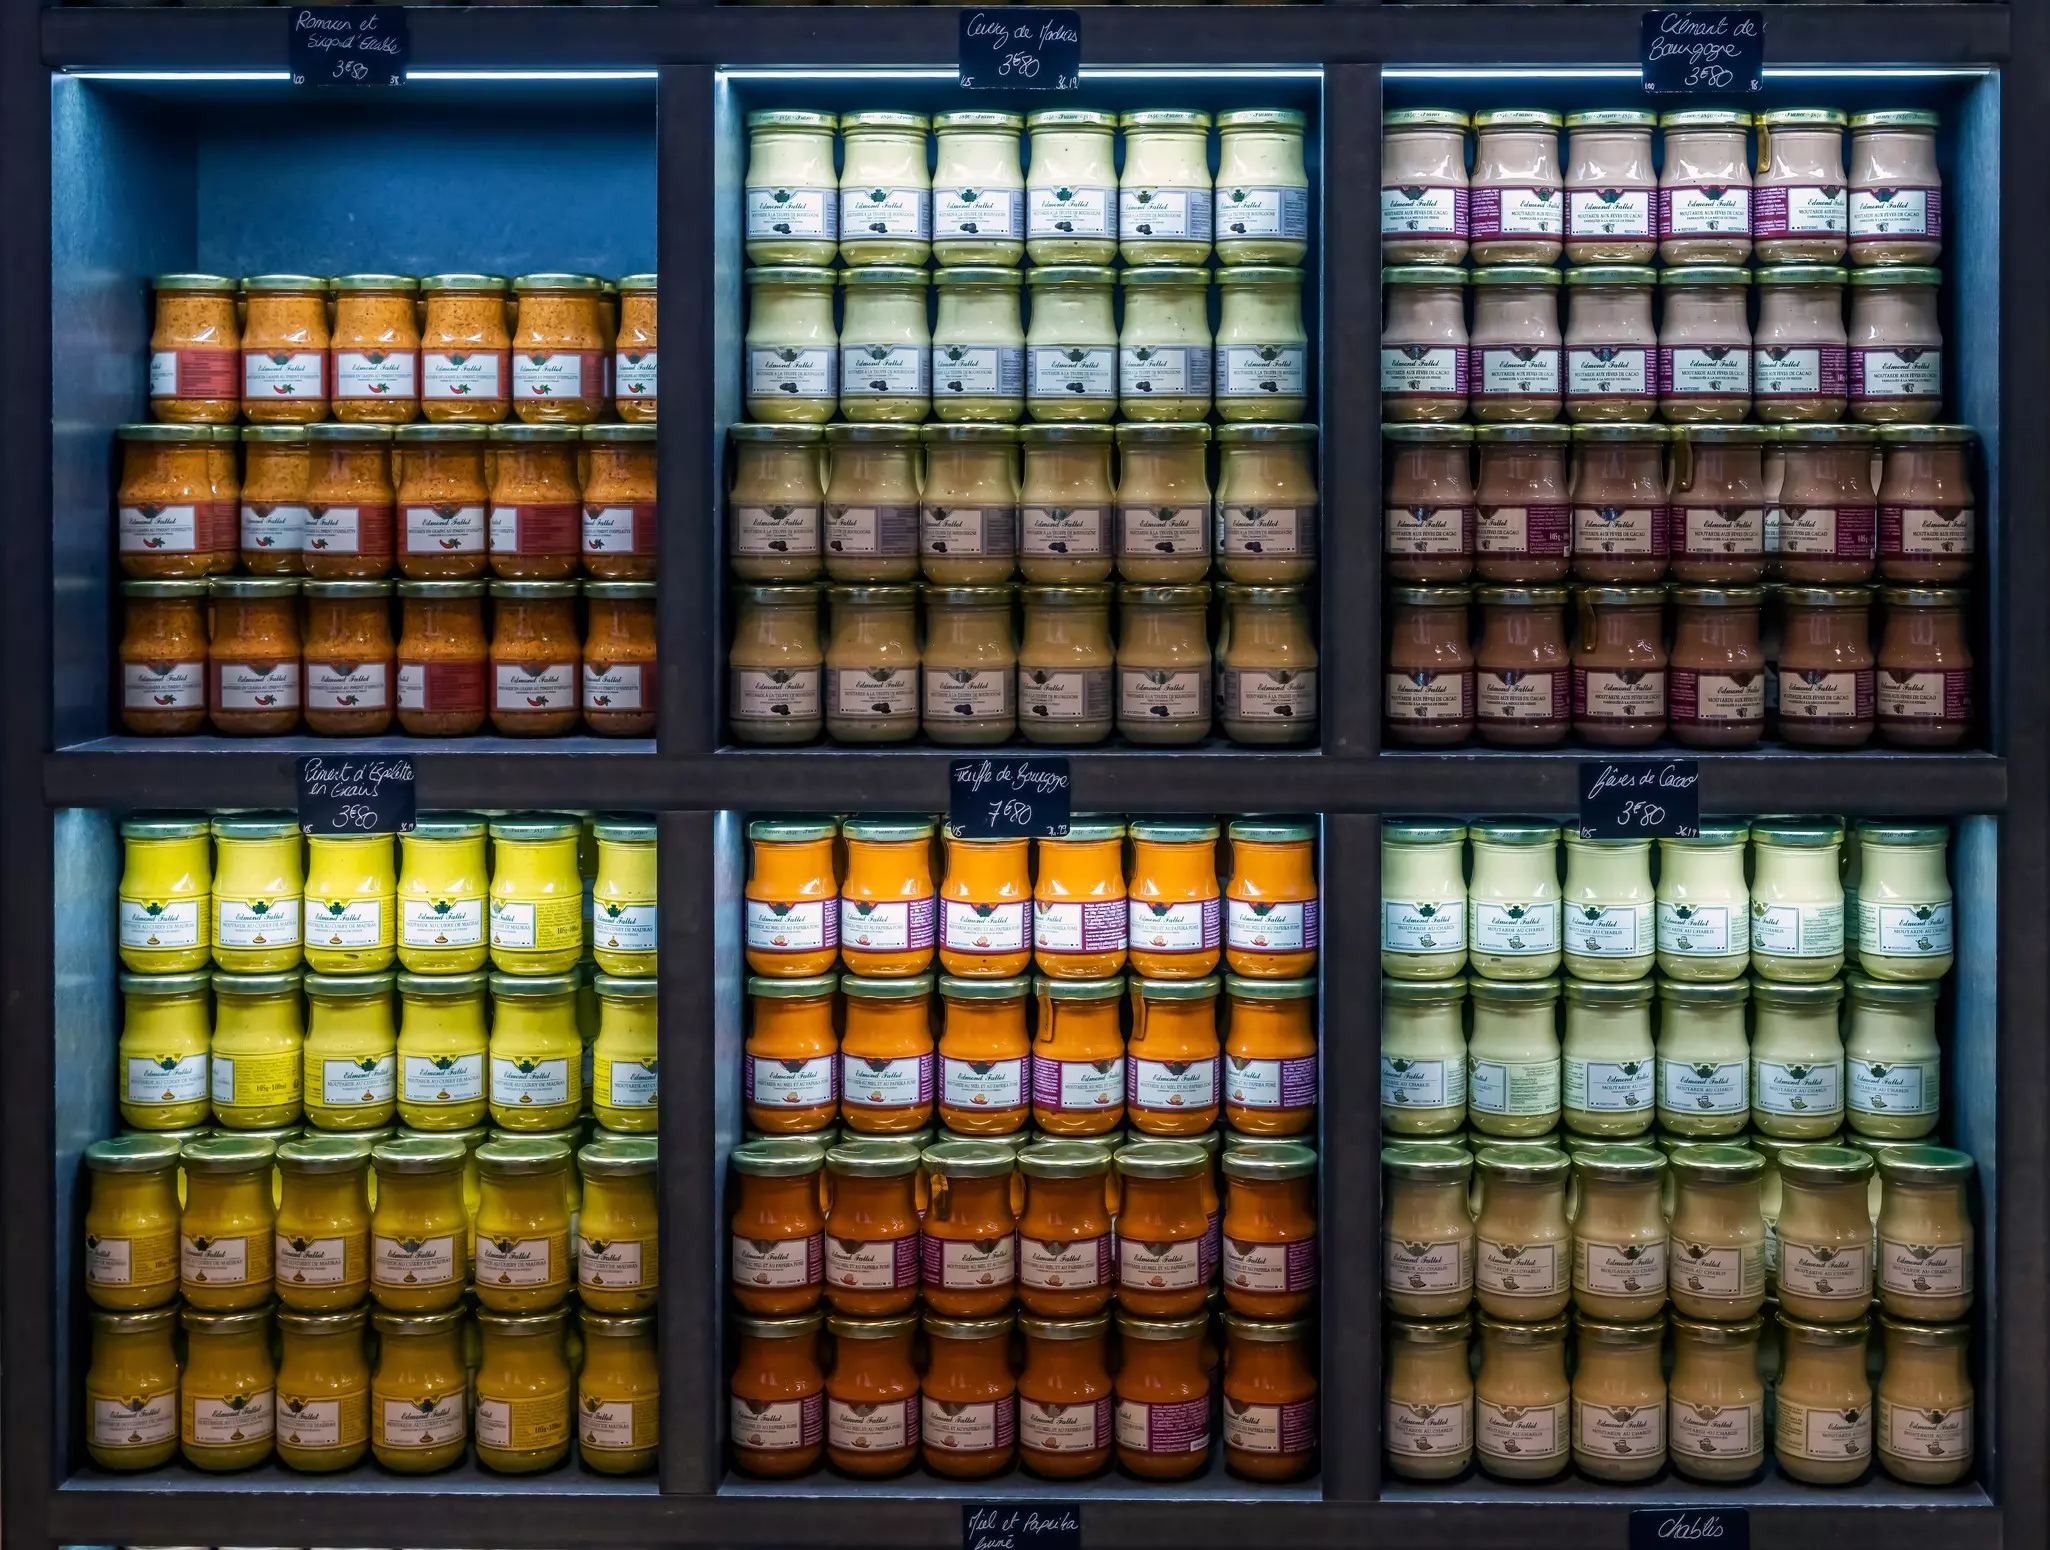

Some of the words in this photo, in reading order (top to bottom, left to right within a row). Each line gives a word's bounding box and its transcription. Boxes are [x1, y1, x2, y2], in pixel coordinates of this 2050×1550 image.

[360, 14, 379, 31] et
[967, 13, 1009, 50] Curry
[1013, 25, 1033, 39] de
[1733, 19, 1758, 37] de
[998, 51, 1040, 78] 3€80
[1684, 65, 1734, 87] 3€80
[995, 765, 1012, 782] de
[1639, 769, 1656, 785] de
[1659, 764, 1699, 788] Cacao
[308, 783, 327, 796] en
[332, 804, 378, 829] 3€80
[1617, 800, 1666, 827] 3€80
[1001, 1511, 1020, 1532] et
[1022, 1511, 1080, 1535] Paprika
[1658, 1513, 1724, 1539] Chablis
